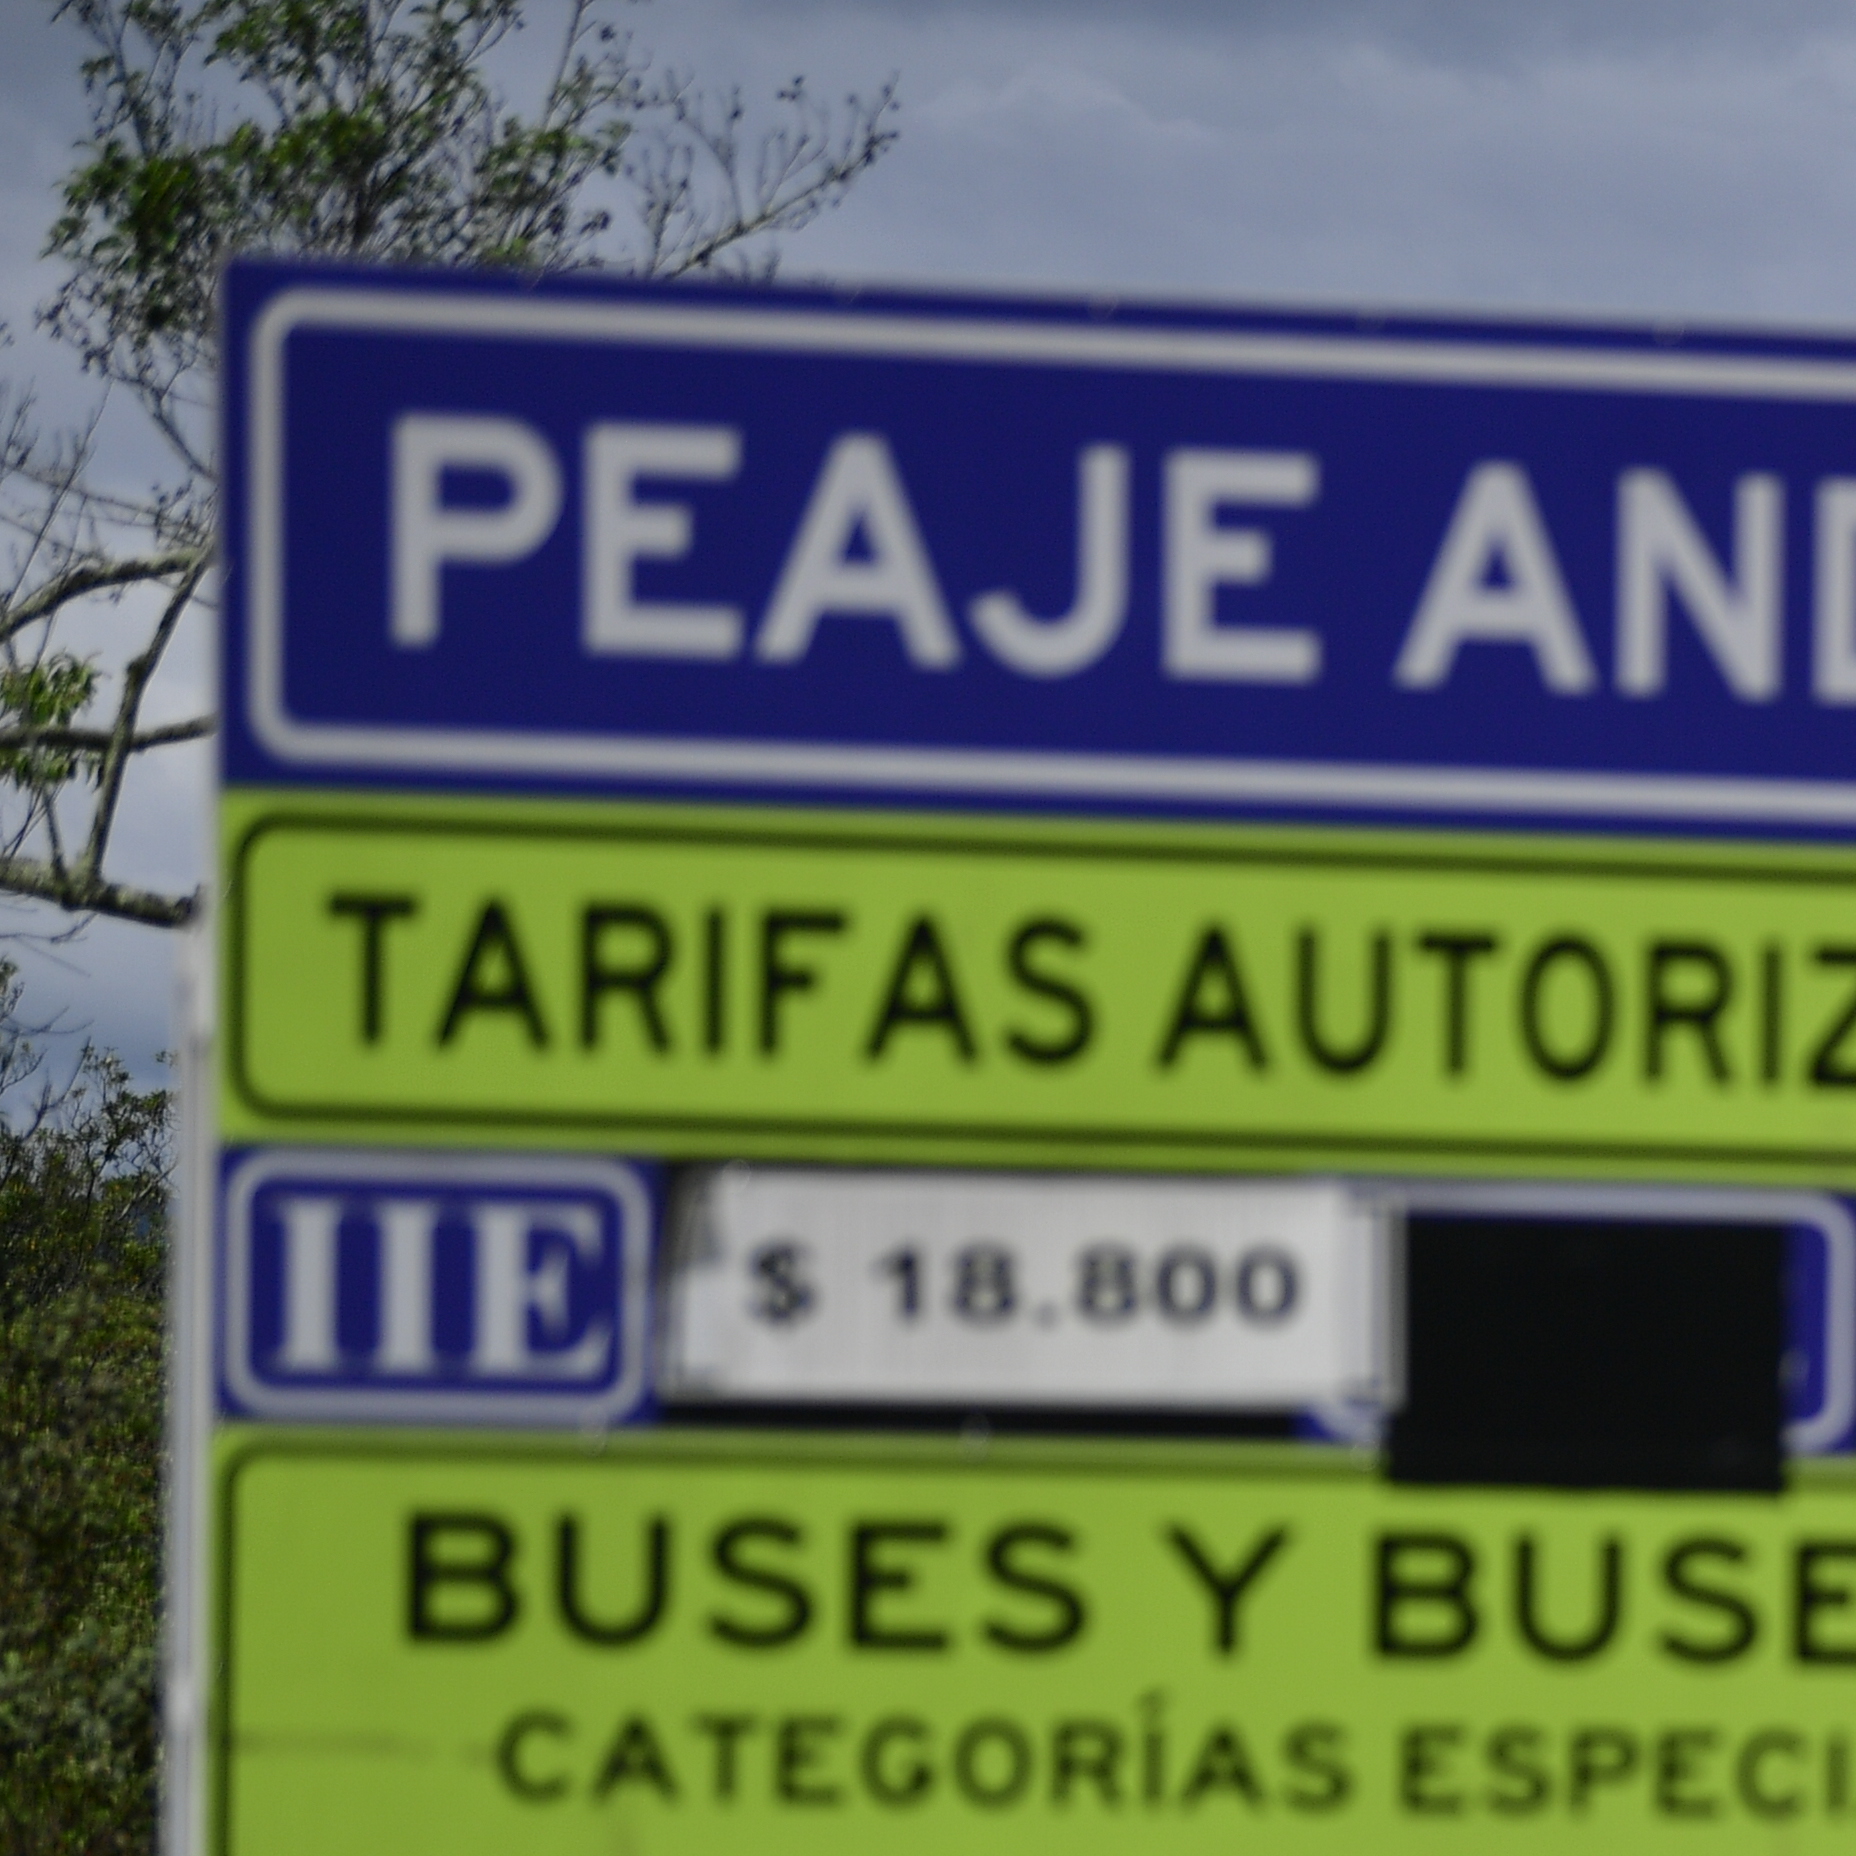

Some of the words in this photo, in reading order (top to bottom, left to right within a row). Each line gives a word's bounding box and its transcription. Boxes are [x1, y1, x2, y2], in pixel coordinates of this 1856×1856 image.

[390, 412, 1322, 686] PEAJE
[322, 888, 1098, 1072] TARIFAS
[276, 1196, 610, 1378] IIE
[744, 1236, 820, 1332] $
[876, 1240, 1304, 1330] 18.800
[400, 1504, 1092, 1660] BUSES
[1165, 1522, 1291, 1660] Y
[486, 1690, 1356, 1816] CATEGORÍAS
